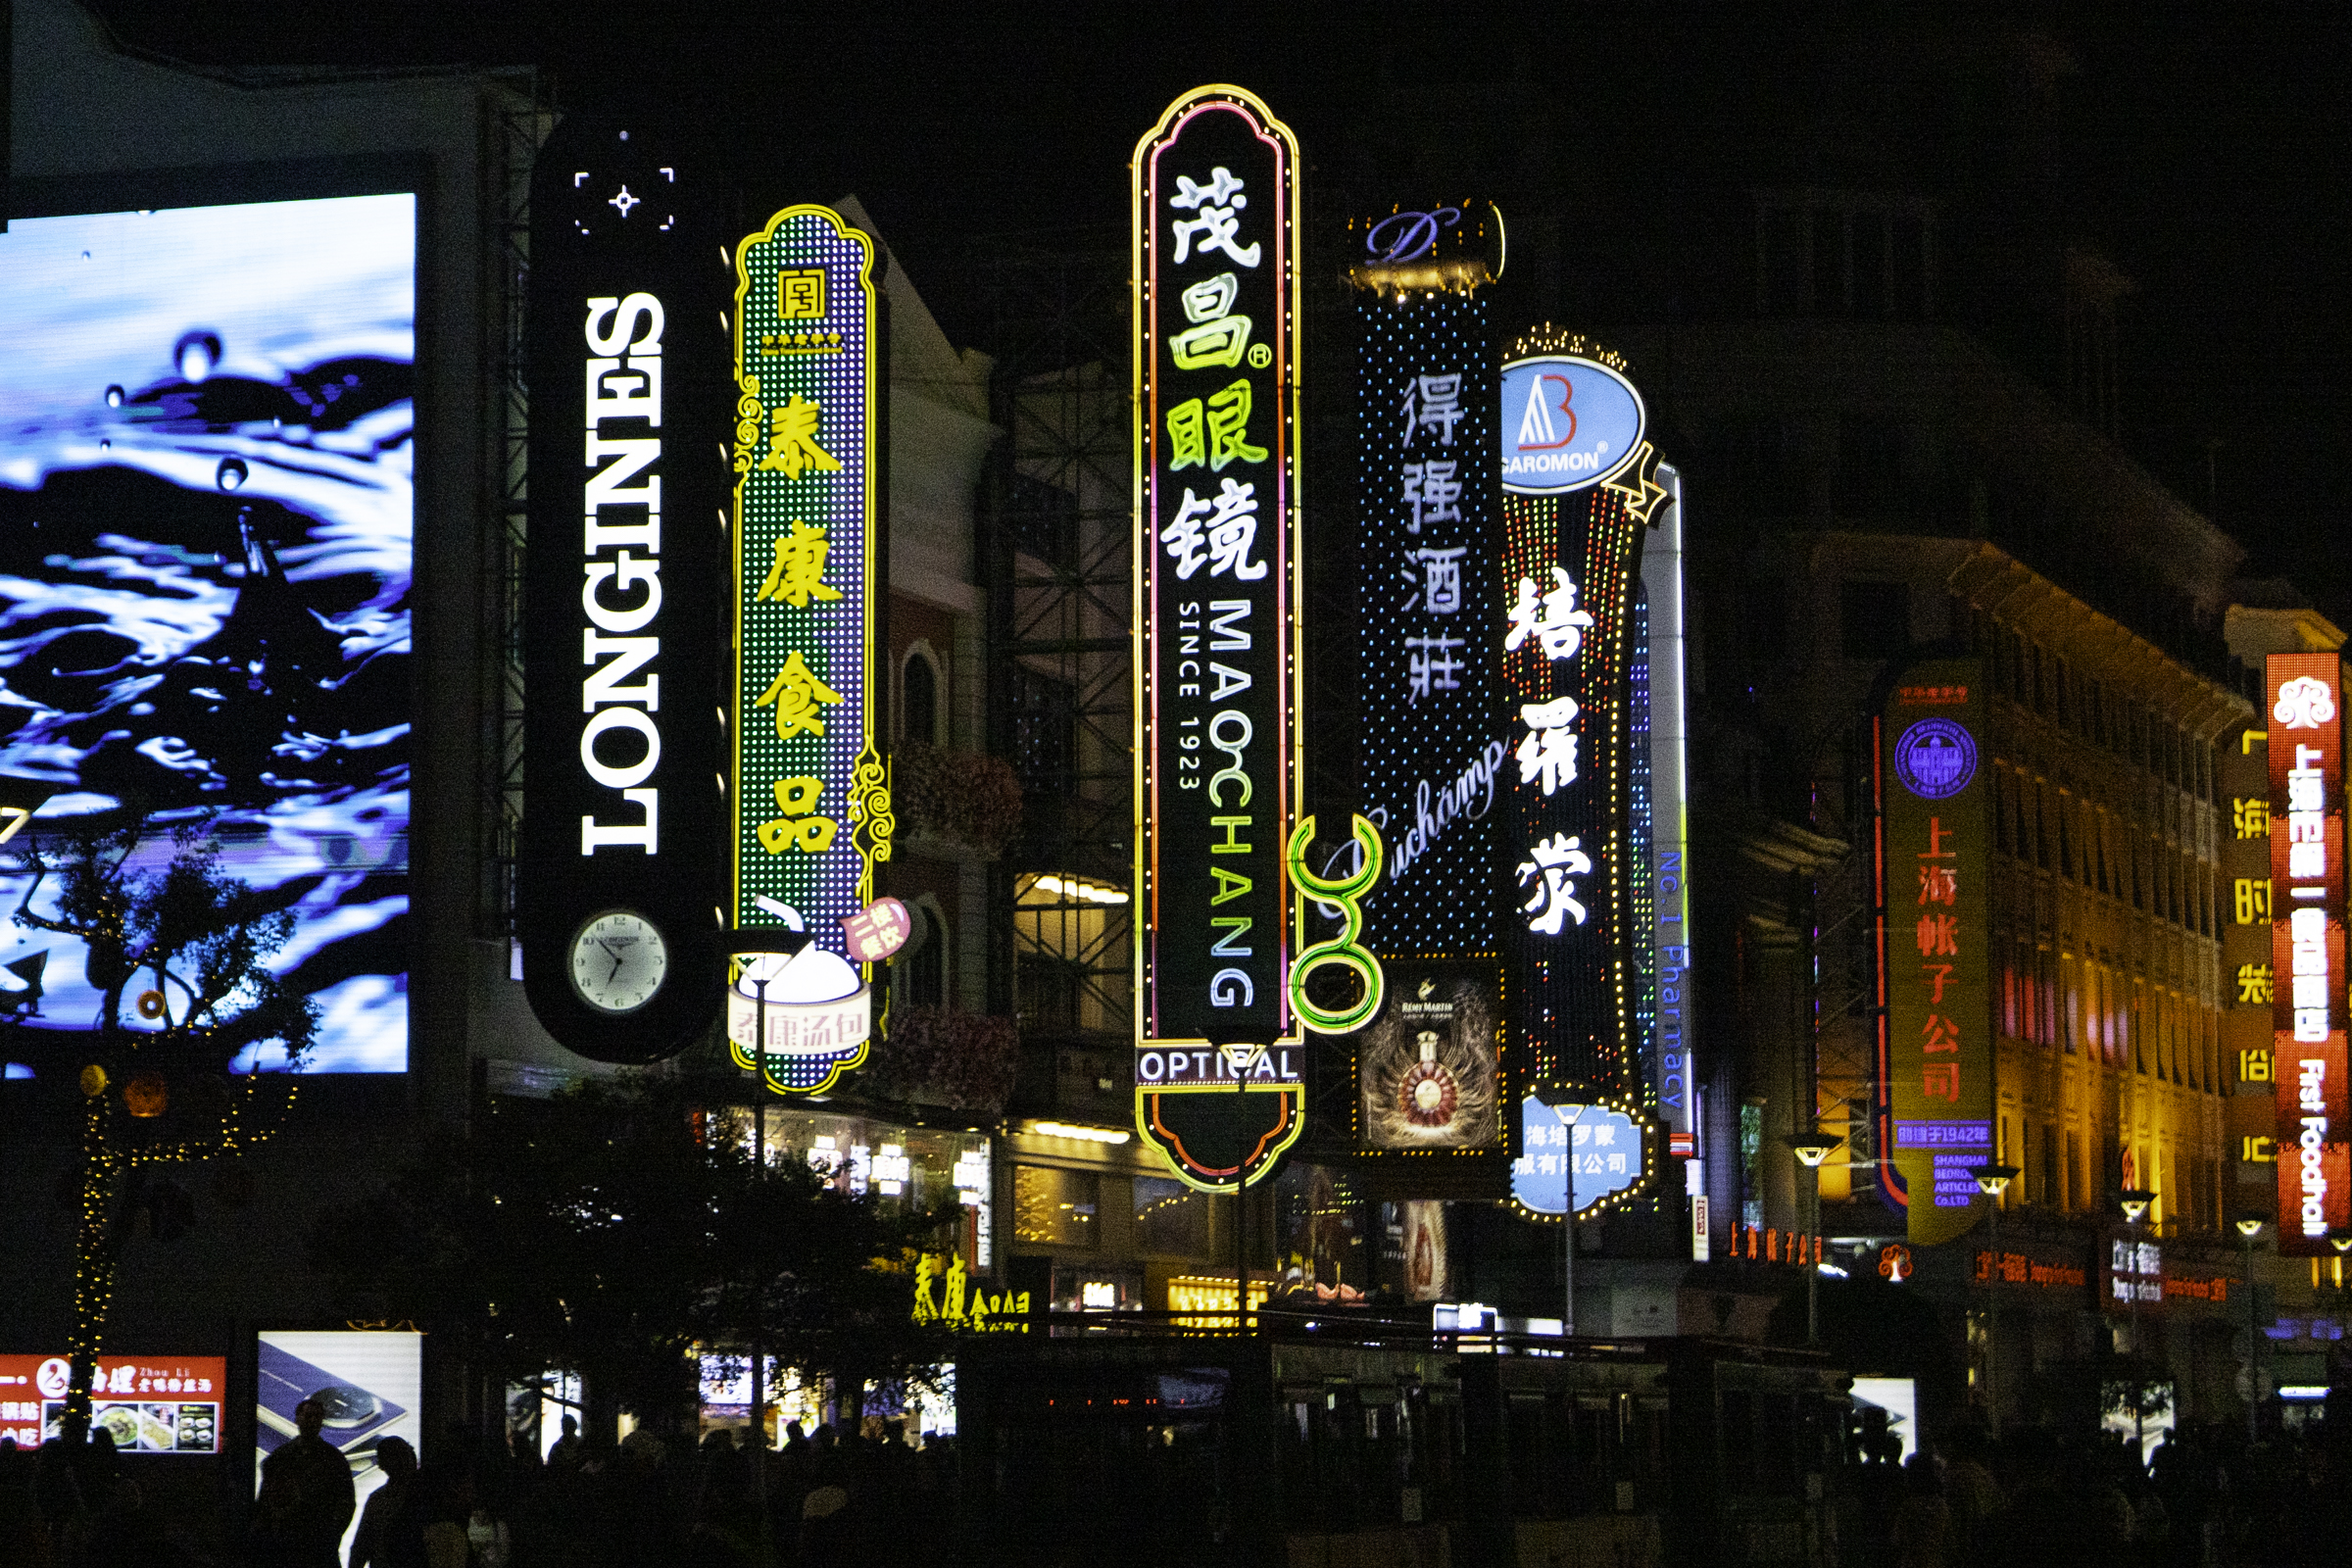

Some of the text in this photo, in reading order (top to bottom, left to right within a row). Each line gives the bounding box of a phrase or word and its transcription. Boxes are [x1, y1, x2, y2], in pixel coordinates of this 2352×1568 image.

[1160, 167, 1267, 582] 茂昌眼镜
[581, 292, 664, 857] LONGINES
[756, 393, 844, 855] 泰康食品
[1179, 603, 1200, 790] SINCE 1923
[1208, 599, 1253, 1007] MAOCHANG
[851, 904, 894, 938] 二楼
[1916, 816, 1960, 1102] 上海帐子公司
[1660, 945, 1684, 1108] Pharmacy
[1934, 1154, 1987, 1166] SHANGHAI
[1934, 1167, 1975, 1180] BEDRO
[1934, 1181, 1980, 1194] ARTICLES
[2298, 1058, 2328, 1238] First Foodhall
[139, 1367, 190, 1377] Zhou Li
